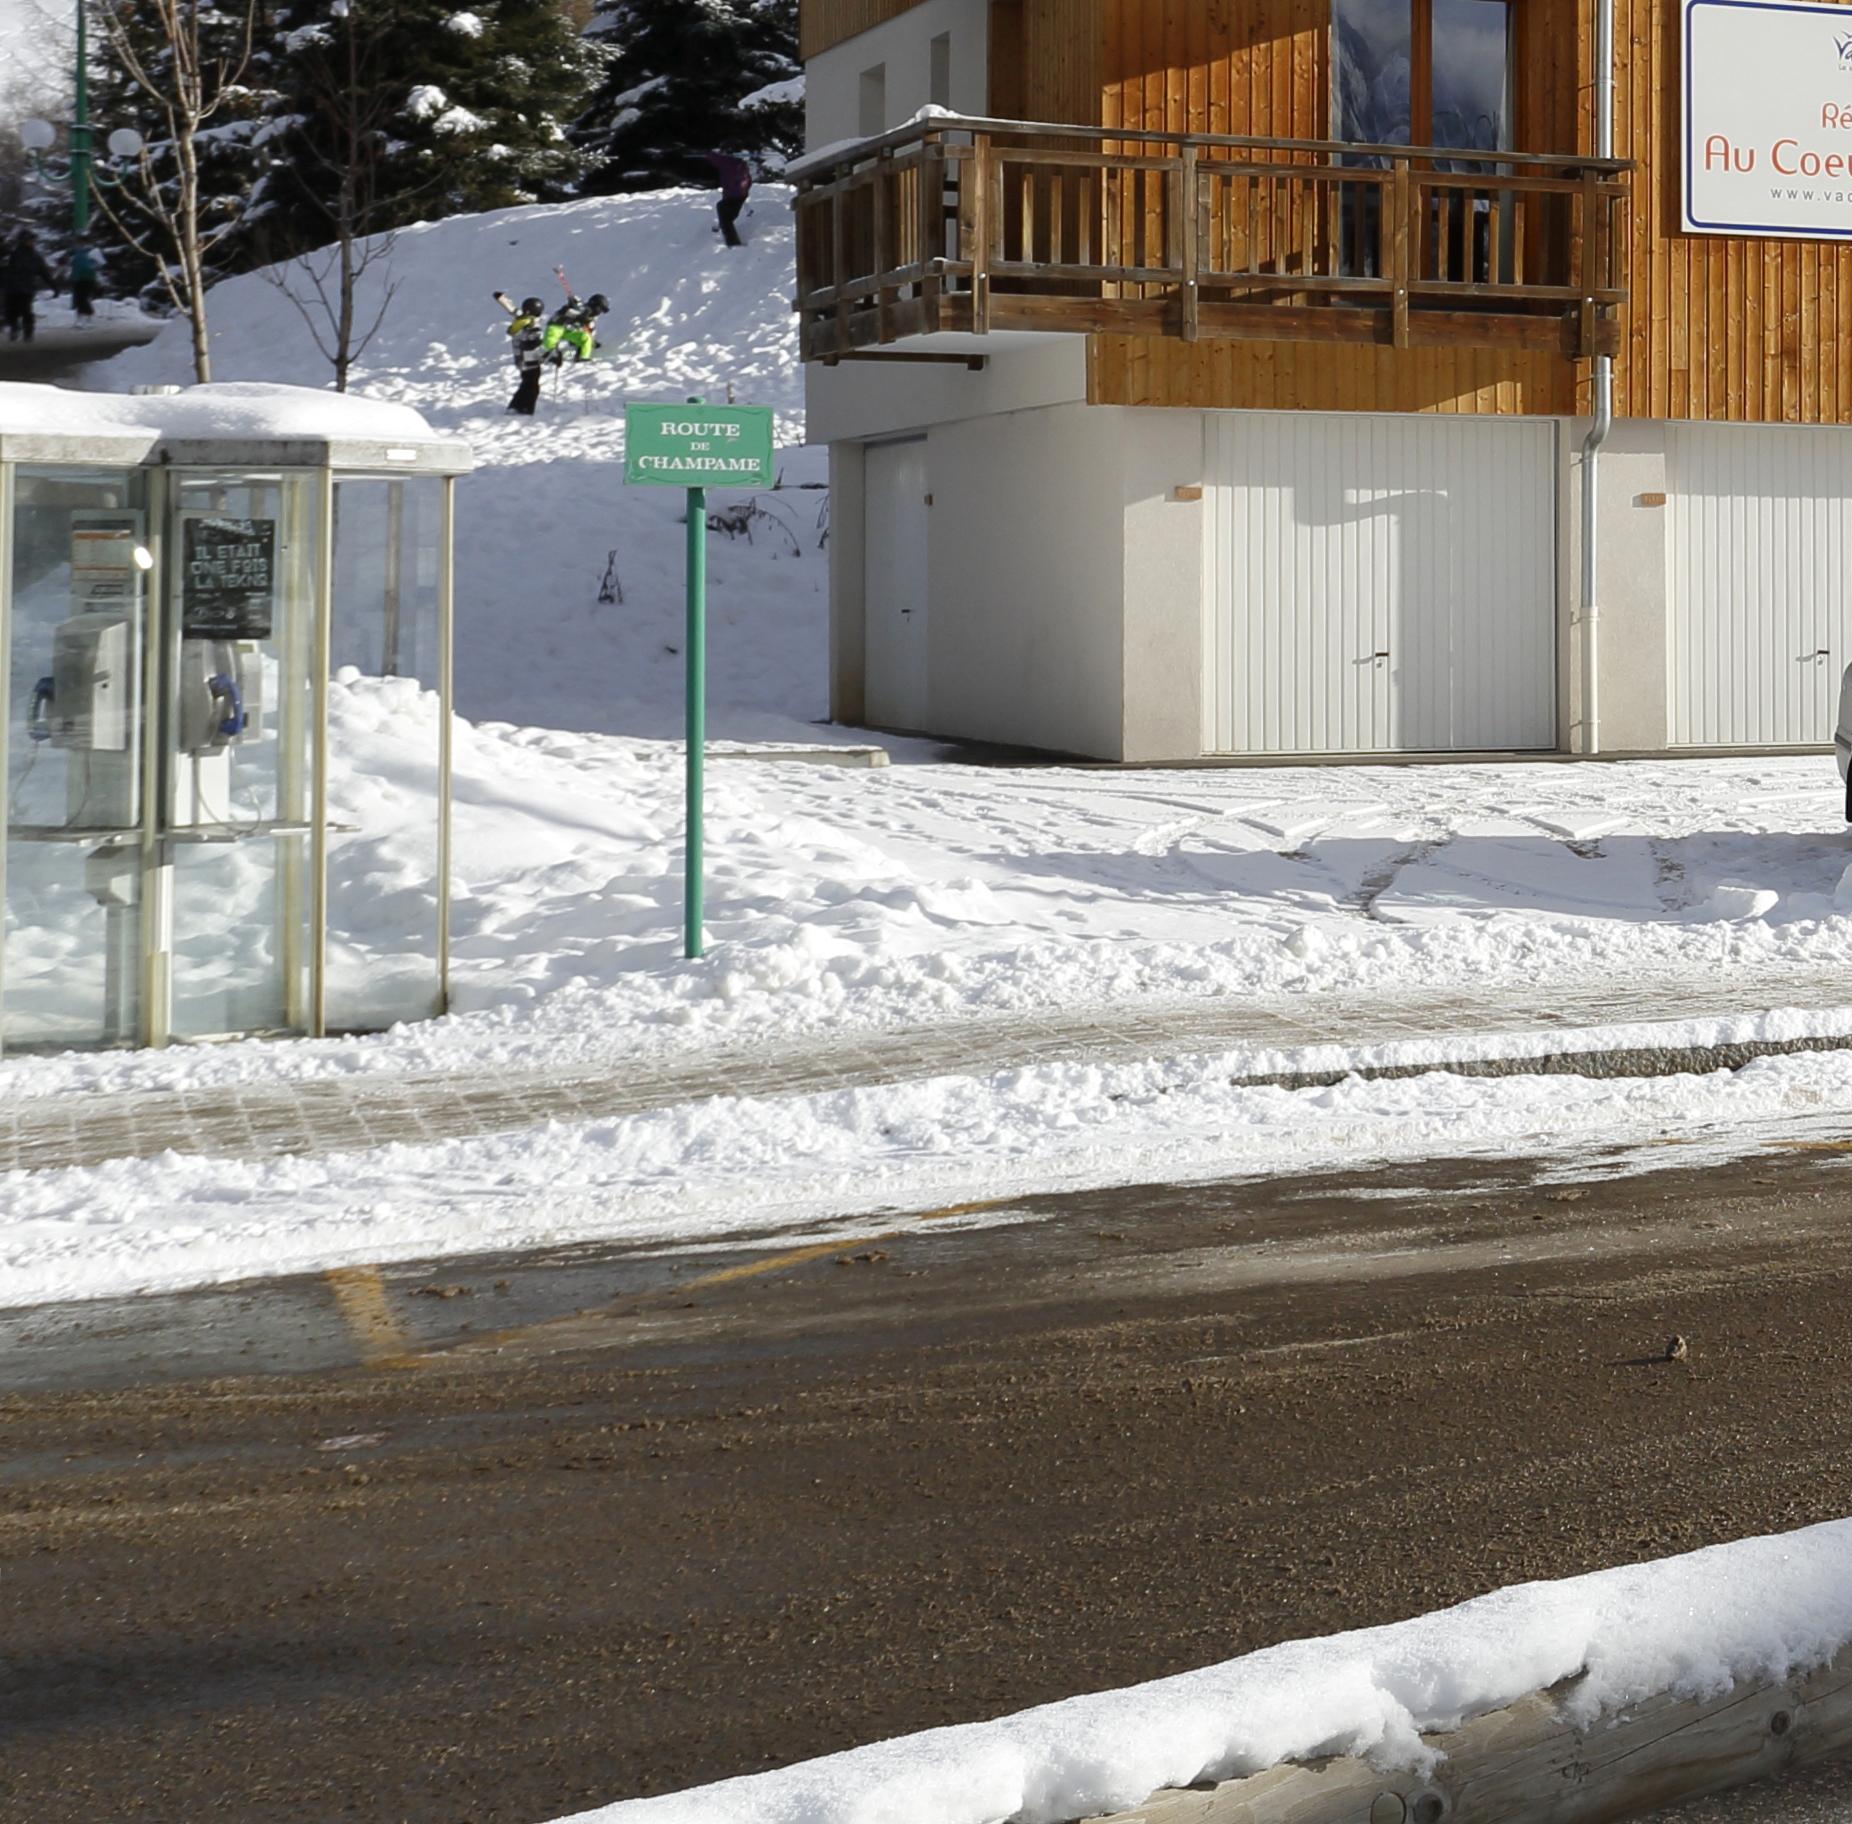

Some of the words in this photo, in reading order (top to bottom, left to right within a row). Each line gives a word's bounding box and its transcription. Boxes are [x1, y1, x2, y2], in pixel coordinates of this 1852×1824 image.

[1704, 134, 1755, 173] Au
[660, 422, 740, 437] ROUTE
[690, 442, 711, 451] DE
[638, 455, 761, 471] CHAMPAME
[195, 546, 212, 560] IL
[194, 575, 215, 589] LA
